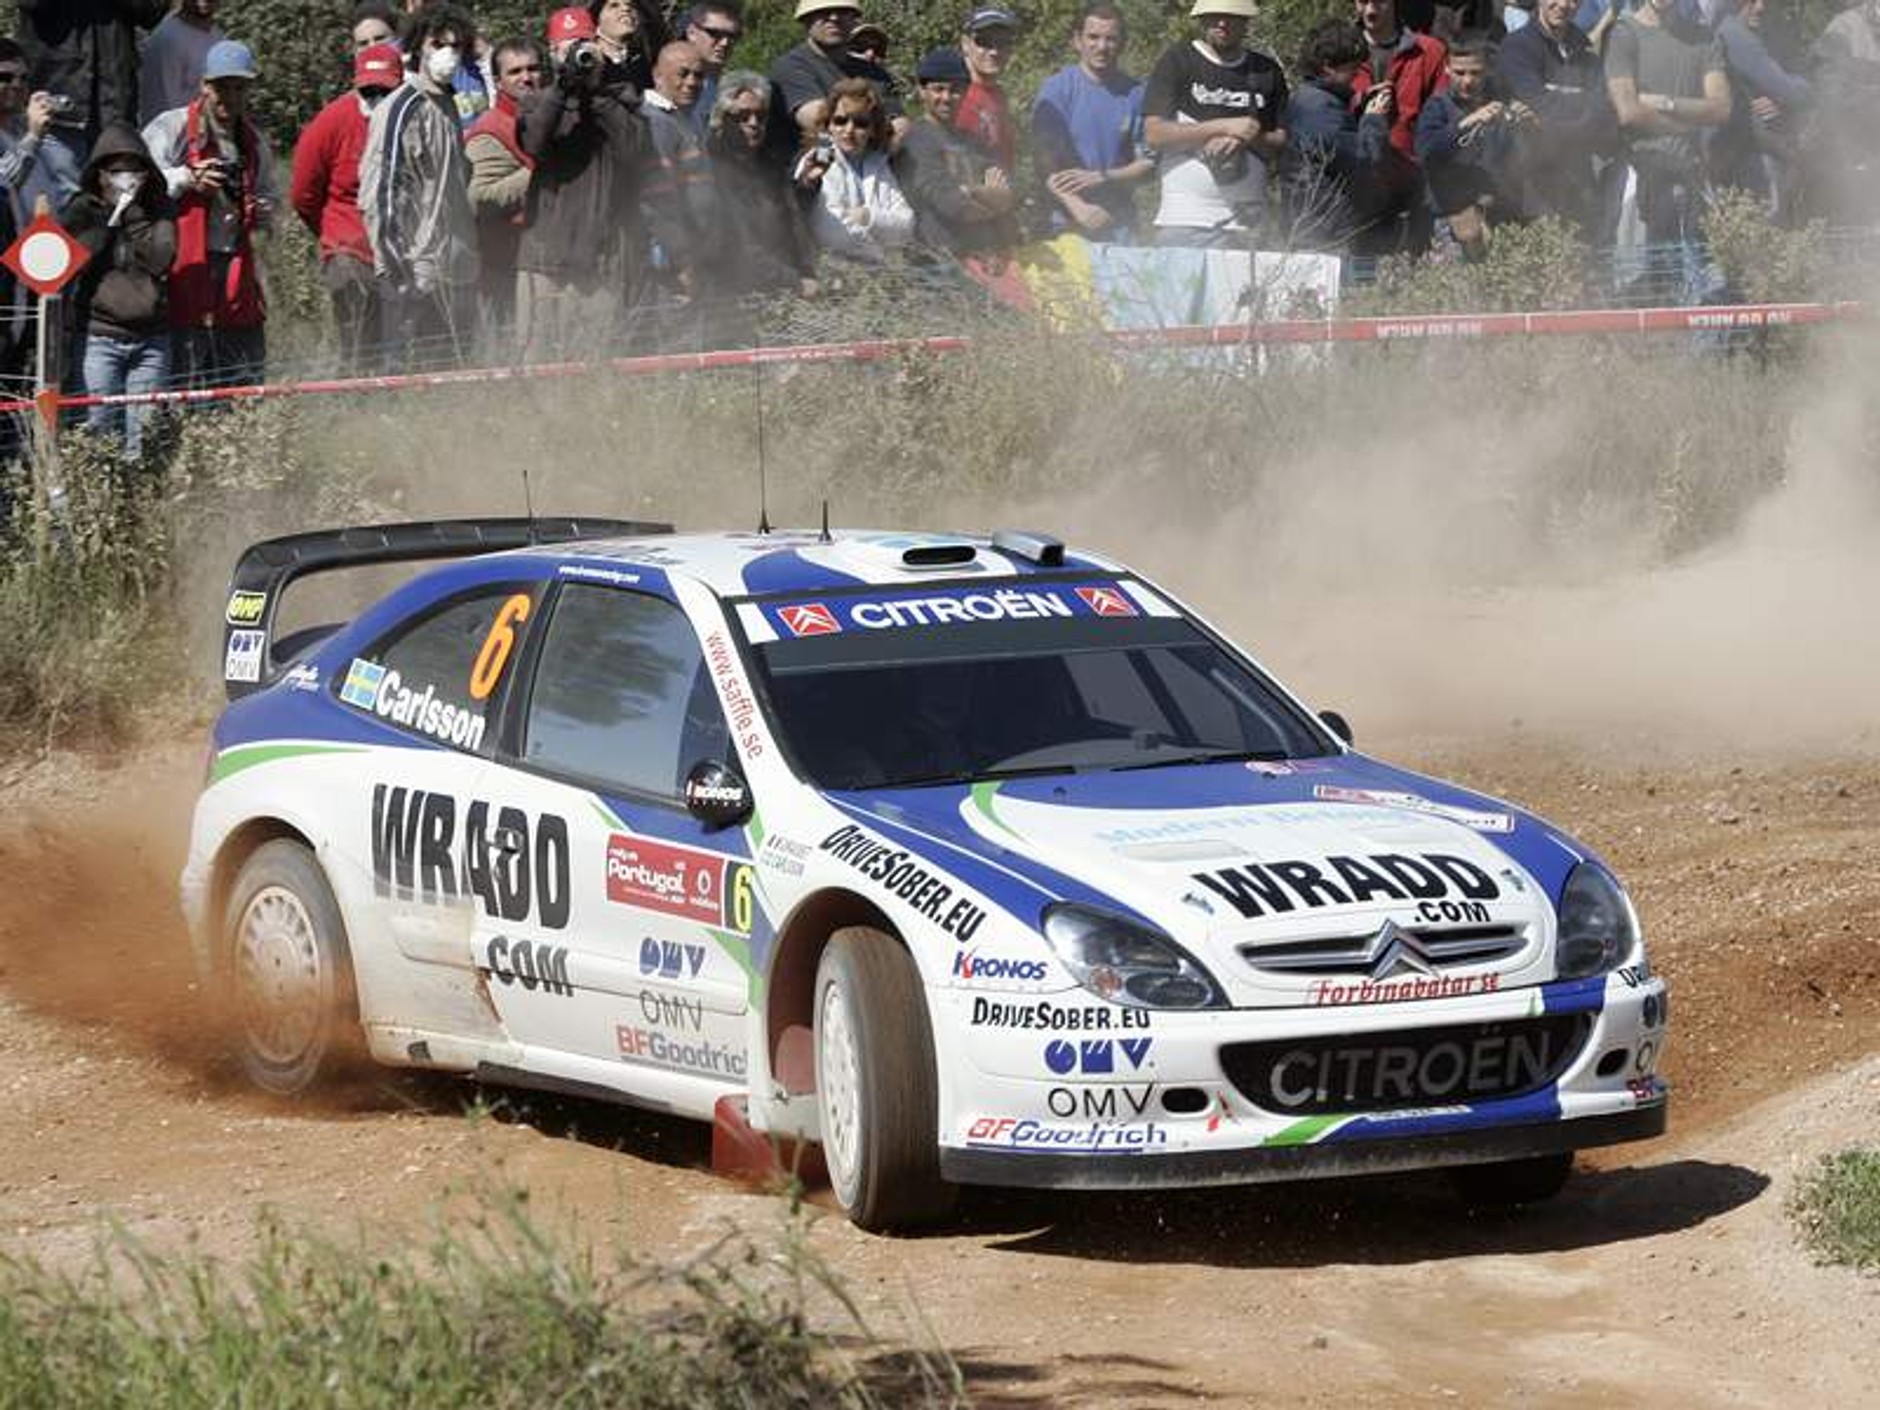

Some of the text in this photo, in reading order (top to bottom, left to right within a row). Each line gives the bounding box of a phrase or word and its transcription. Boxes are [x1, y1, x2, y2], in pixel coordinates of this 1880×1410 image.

[850, 590, 1073, 629] CITROËN
[470, 594, 530, 699] 6
[376, 669, 486, 750] Carlsson
[371, 783, 571, 930] WRADD
[609, 857, 685, 894] Portugal
[733, 866, 752, 932] 6
[1190, 853, 1500, 919] WRADD
[1414, 901, 1491, 923] .COM
[952, 946, 1048, 980] KRONOS
[639, 989, 703, 1031] OMV
[1269, 1025, 1553, 1107] CITROËN
[1047, 1083, 1154, 1118] OMV
[967, 1117, 1168, 1148] BFGoodrich
